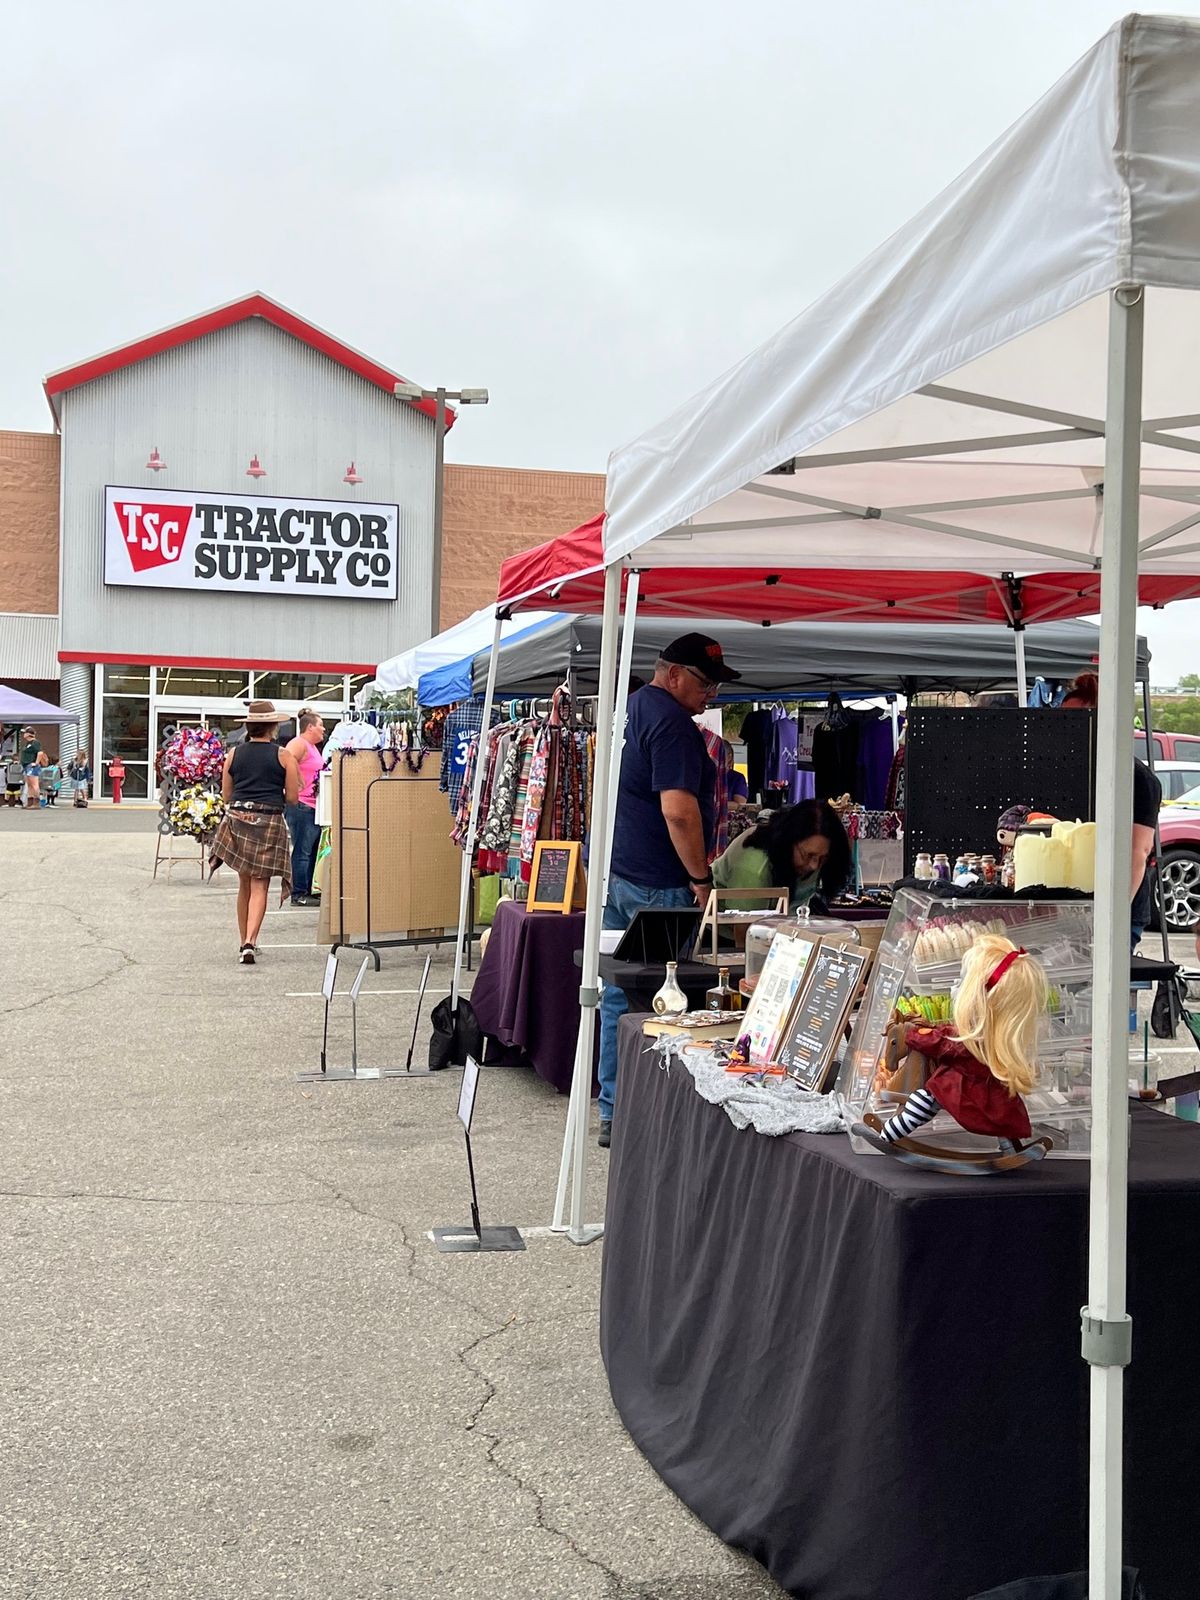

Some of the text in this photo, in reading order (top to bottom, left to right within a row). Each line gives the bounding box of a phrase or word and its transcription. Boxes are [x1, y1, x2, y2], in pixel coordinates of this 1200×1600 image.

[122, 504, 180, 561] TSC
[195, 503, 389, 549] TRACTOR
[194, 543, 343, 585] SUPPLY
